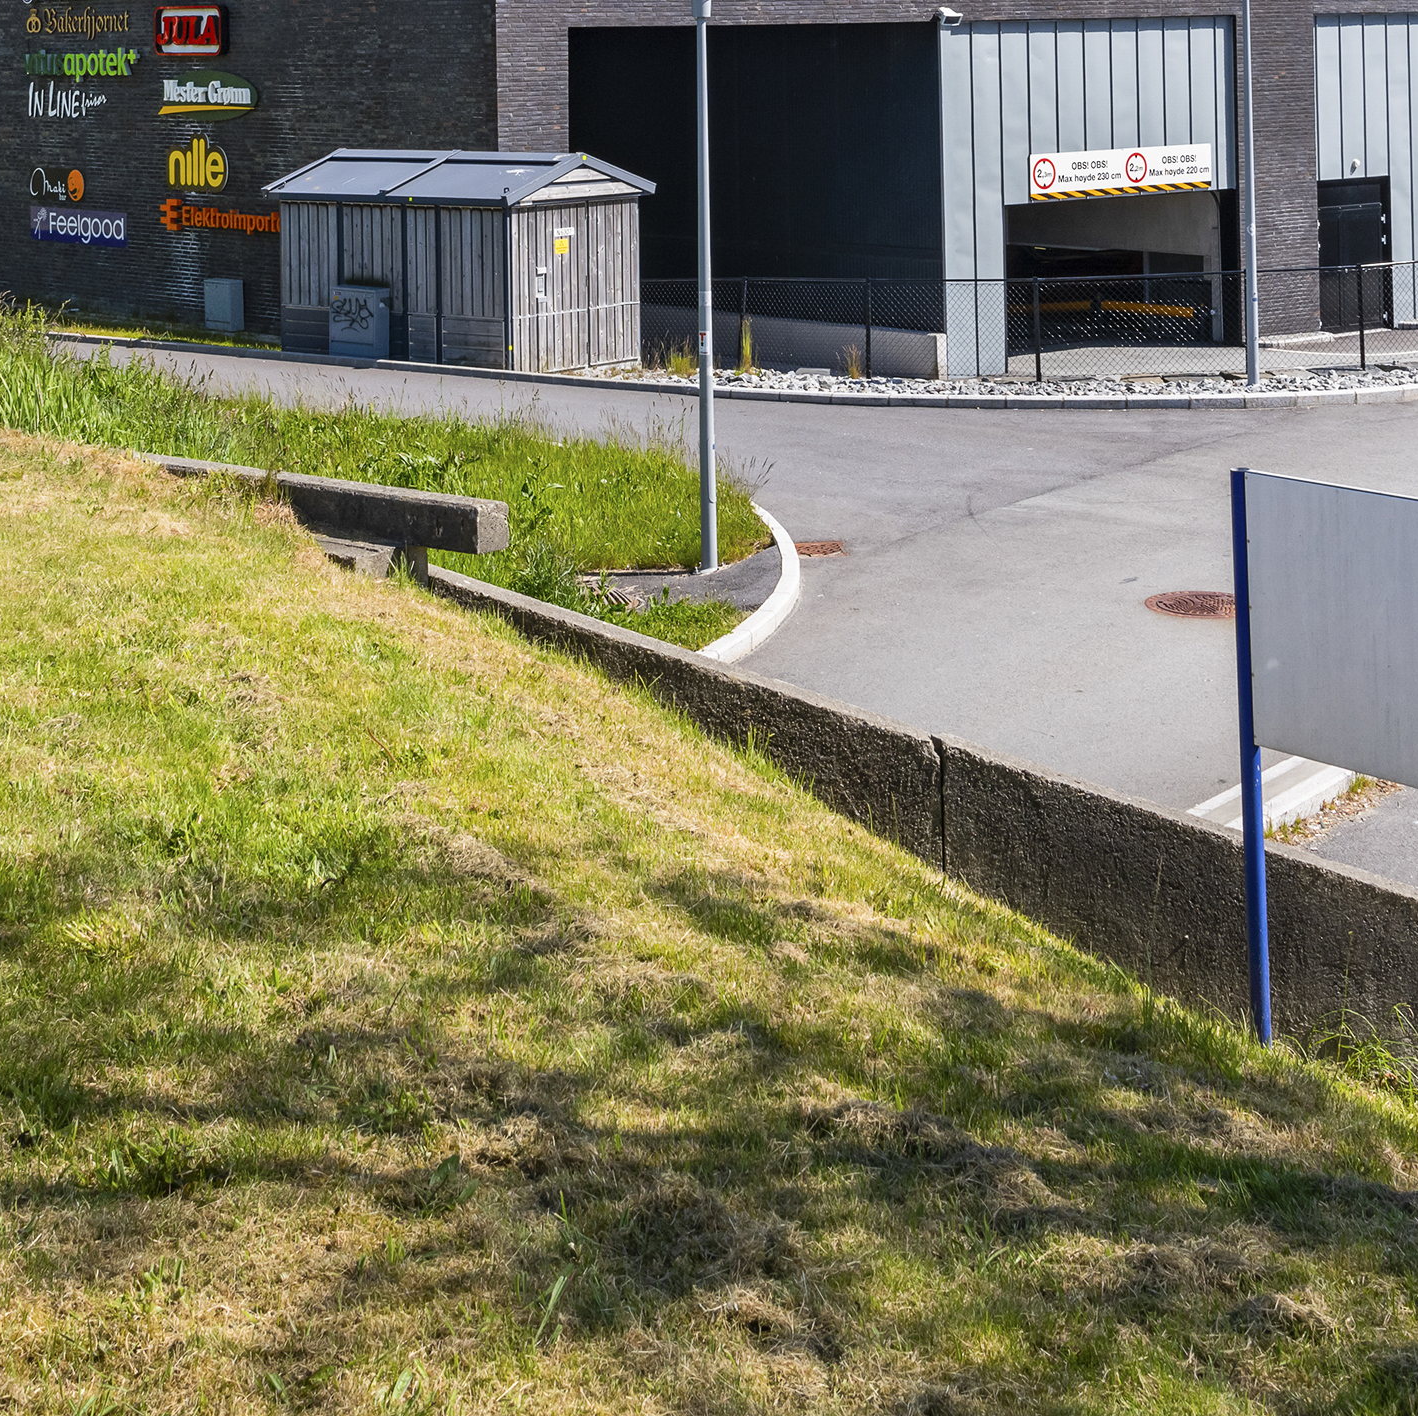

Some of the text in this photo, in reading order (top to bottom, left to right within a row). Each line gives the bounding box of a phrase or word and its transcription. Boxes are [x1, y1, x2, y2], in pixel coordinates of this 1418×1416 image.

[156, 15, 219, 46] JULA
[48, 80, 80, 118] LINE
[163, 79, 208, 103] Mester
[168, 138, 225, 187] nille
[1097, 173, 1110, 181] 230
[1186, 166, 1198, 175] 220
[1199, 166, 1210, 174] cm
[49, 212, 125, 244] Feelgood
